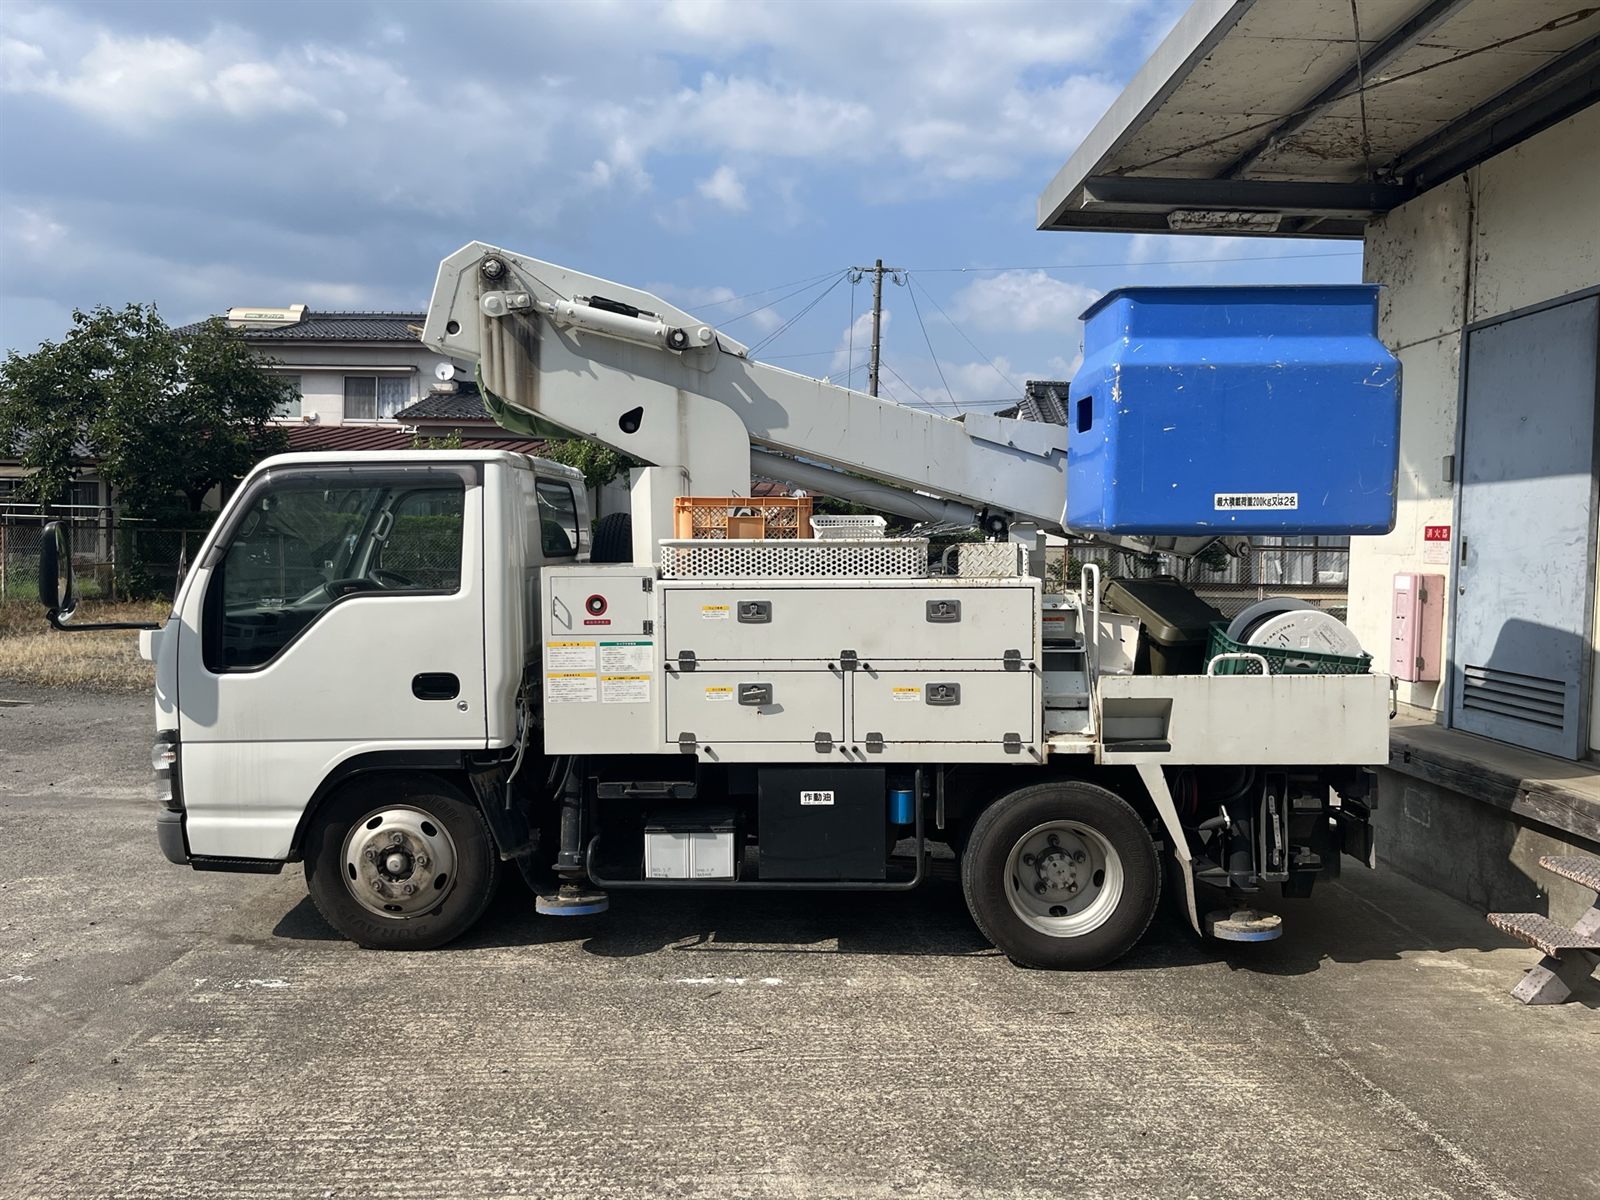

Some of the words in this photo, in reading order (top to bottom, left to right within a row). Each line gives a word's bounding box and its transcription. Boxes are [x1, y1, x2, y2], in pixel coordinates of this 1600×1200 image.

[1426, 528, 1448, 539] 消火器
[804, 793, 832, 802] 作動油
